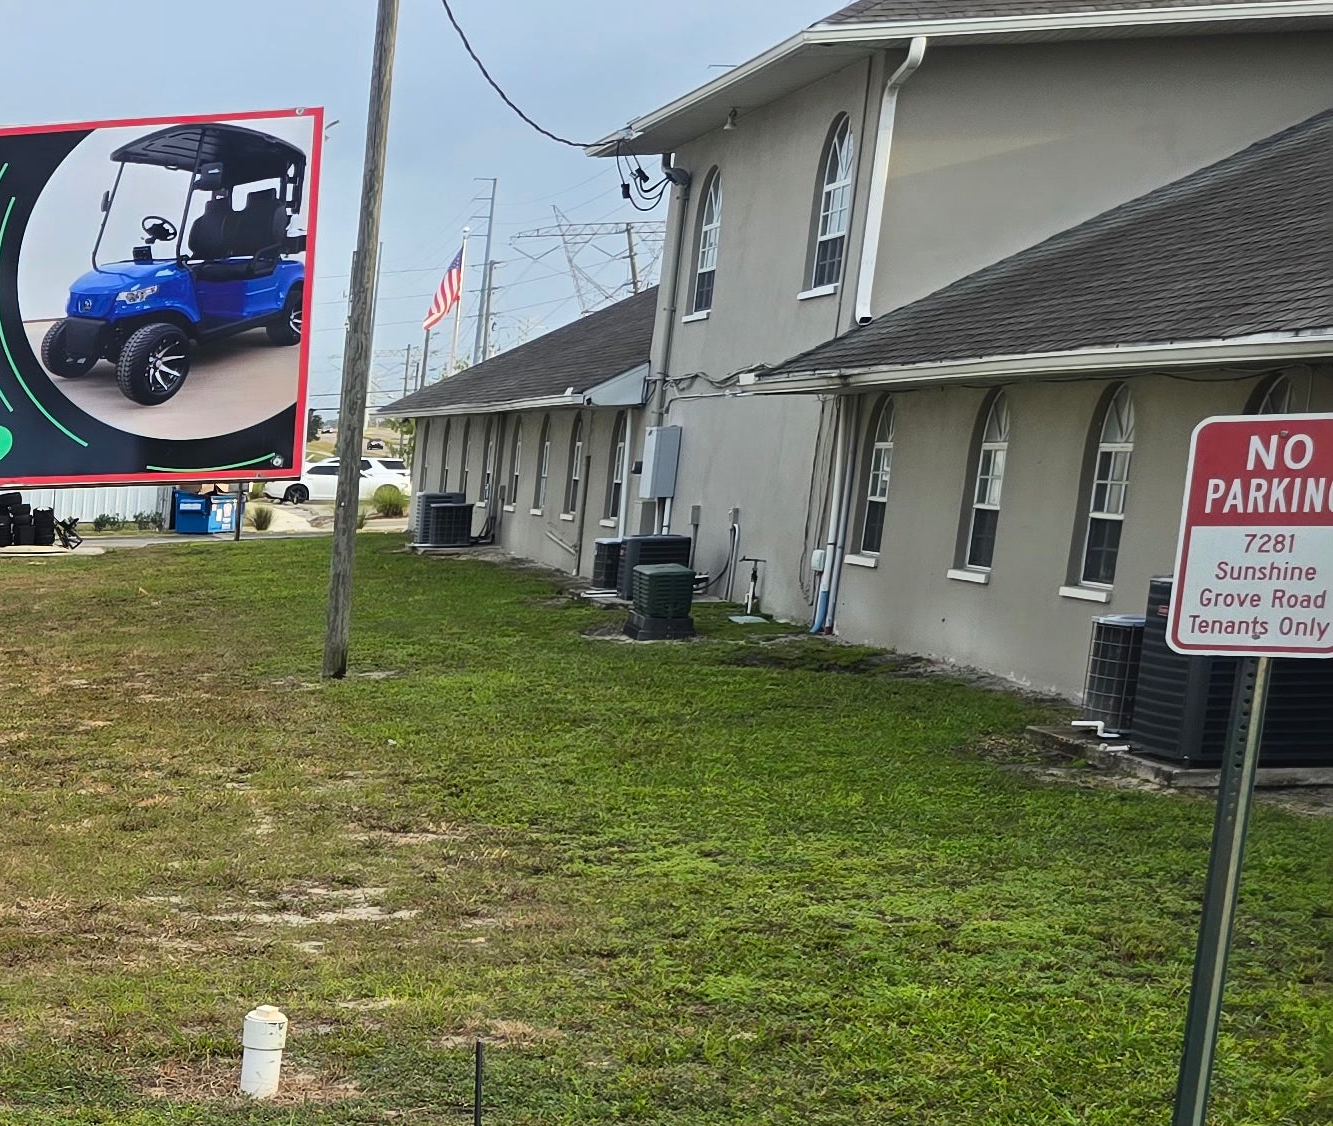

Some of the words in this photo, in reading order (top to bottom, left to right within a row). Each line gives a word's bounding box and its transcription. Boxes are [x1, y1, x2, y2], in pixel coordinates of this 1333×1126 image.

[1245, 433, 1314, 471] NO
[1204, 477, 1333, 514] PARKIN
[1244, 533, 1296, 554] 7281
[1214, 561, 1317, 581] Sunshine
[1199, 588, 1262, 608] Grove
[1271, 588, 1328, 609] Road
[1189, 615, 1269, 636] Tenants
[1278, 617, 1330, 641] Only
